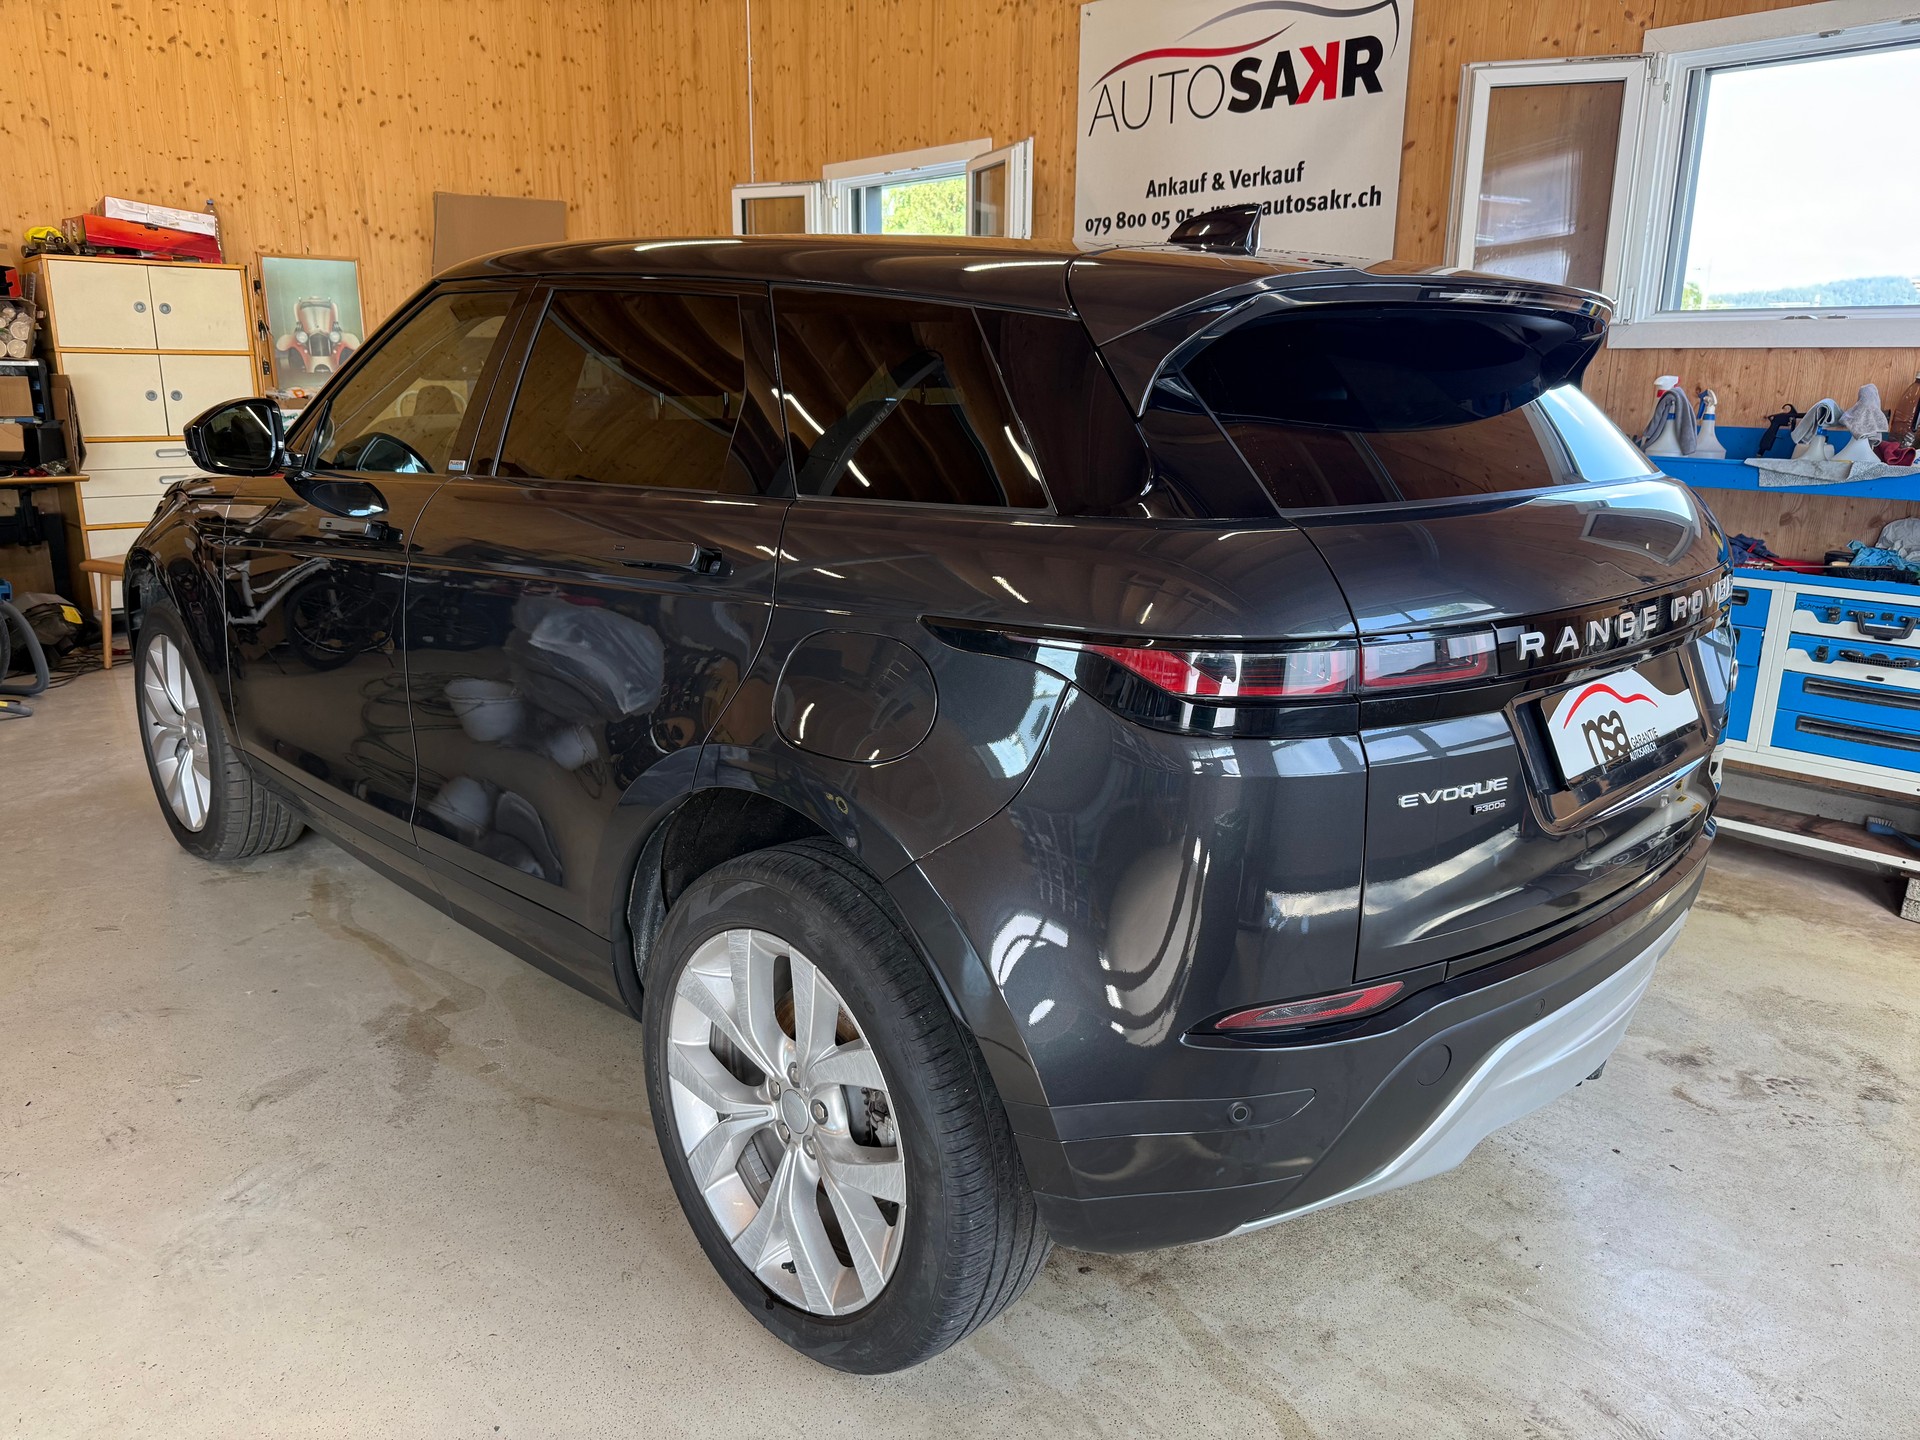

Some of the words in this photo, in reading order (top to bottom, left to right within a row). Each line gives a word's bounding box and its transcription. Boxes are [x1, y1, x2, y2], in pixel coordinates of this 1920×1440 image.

[1145, 172, 1208, 199] Ankauf
[1211, 172, 1226, 191] &
[1229, 160, 1306, 189] Verkauf
[1085, 214, 1112, 237] 079
[1115, 209, 1147, 229] 800
[1151, 210, 1171, 230] 05
[1518, 604, 1658, 661] RANGE
[1581, 710, 1632, 766] nsa
[1630, 727, 1659, 748] GARANTIE
[1398, 777, 1508, 808] EVOQUE
[1475, 801, 1506, 814] P300e
